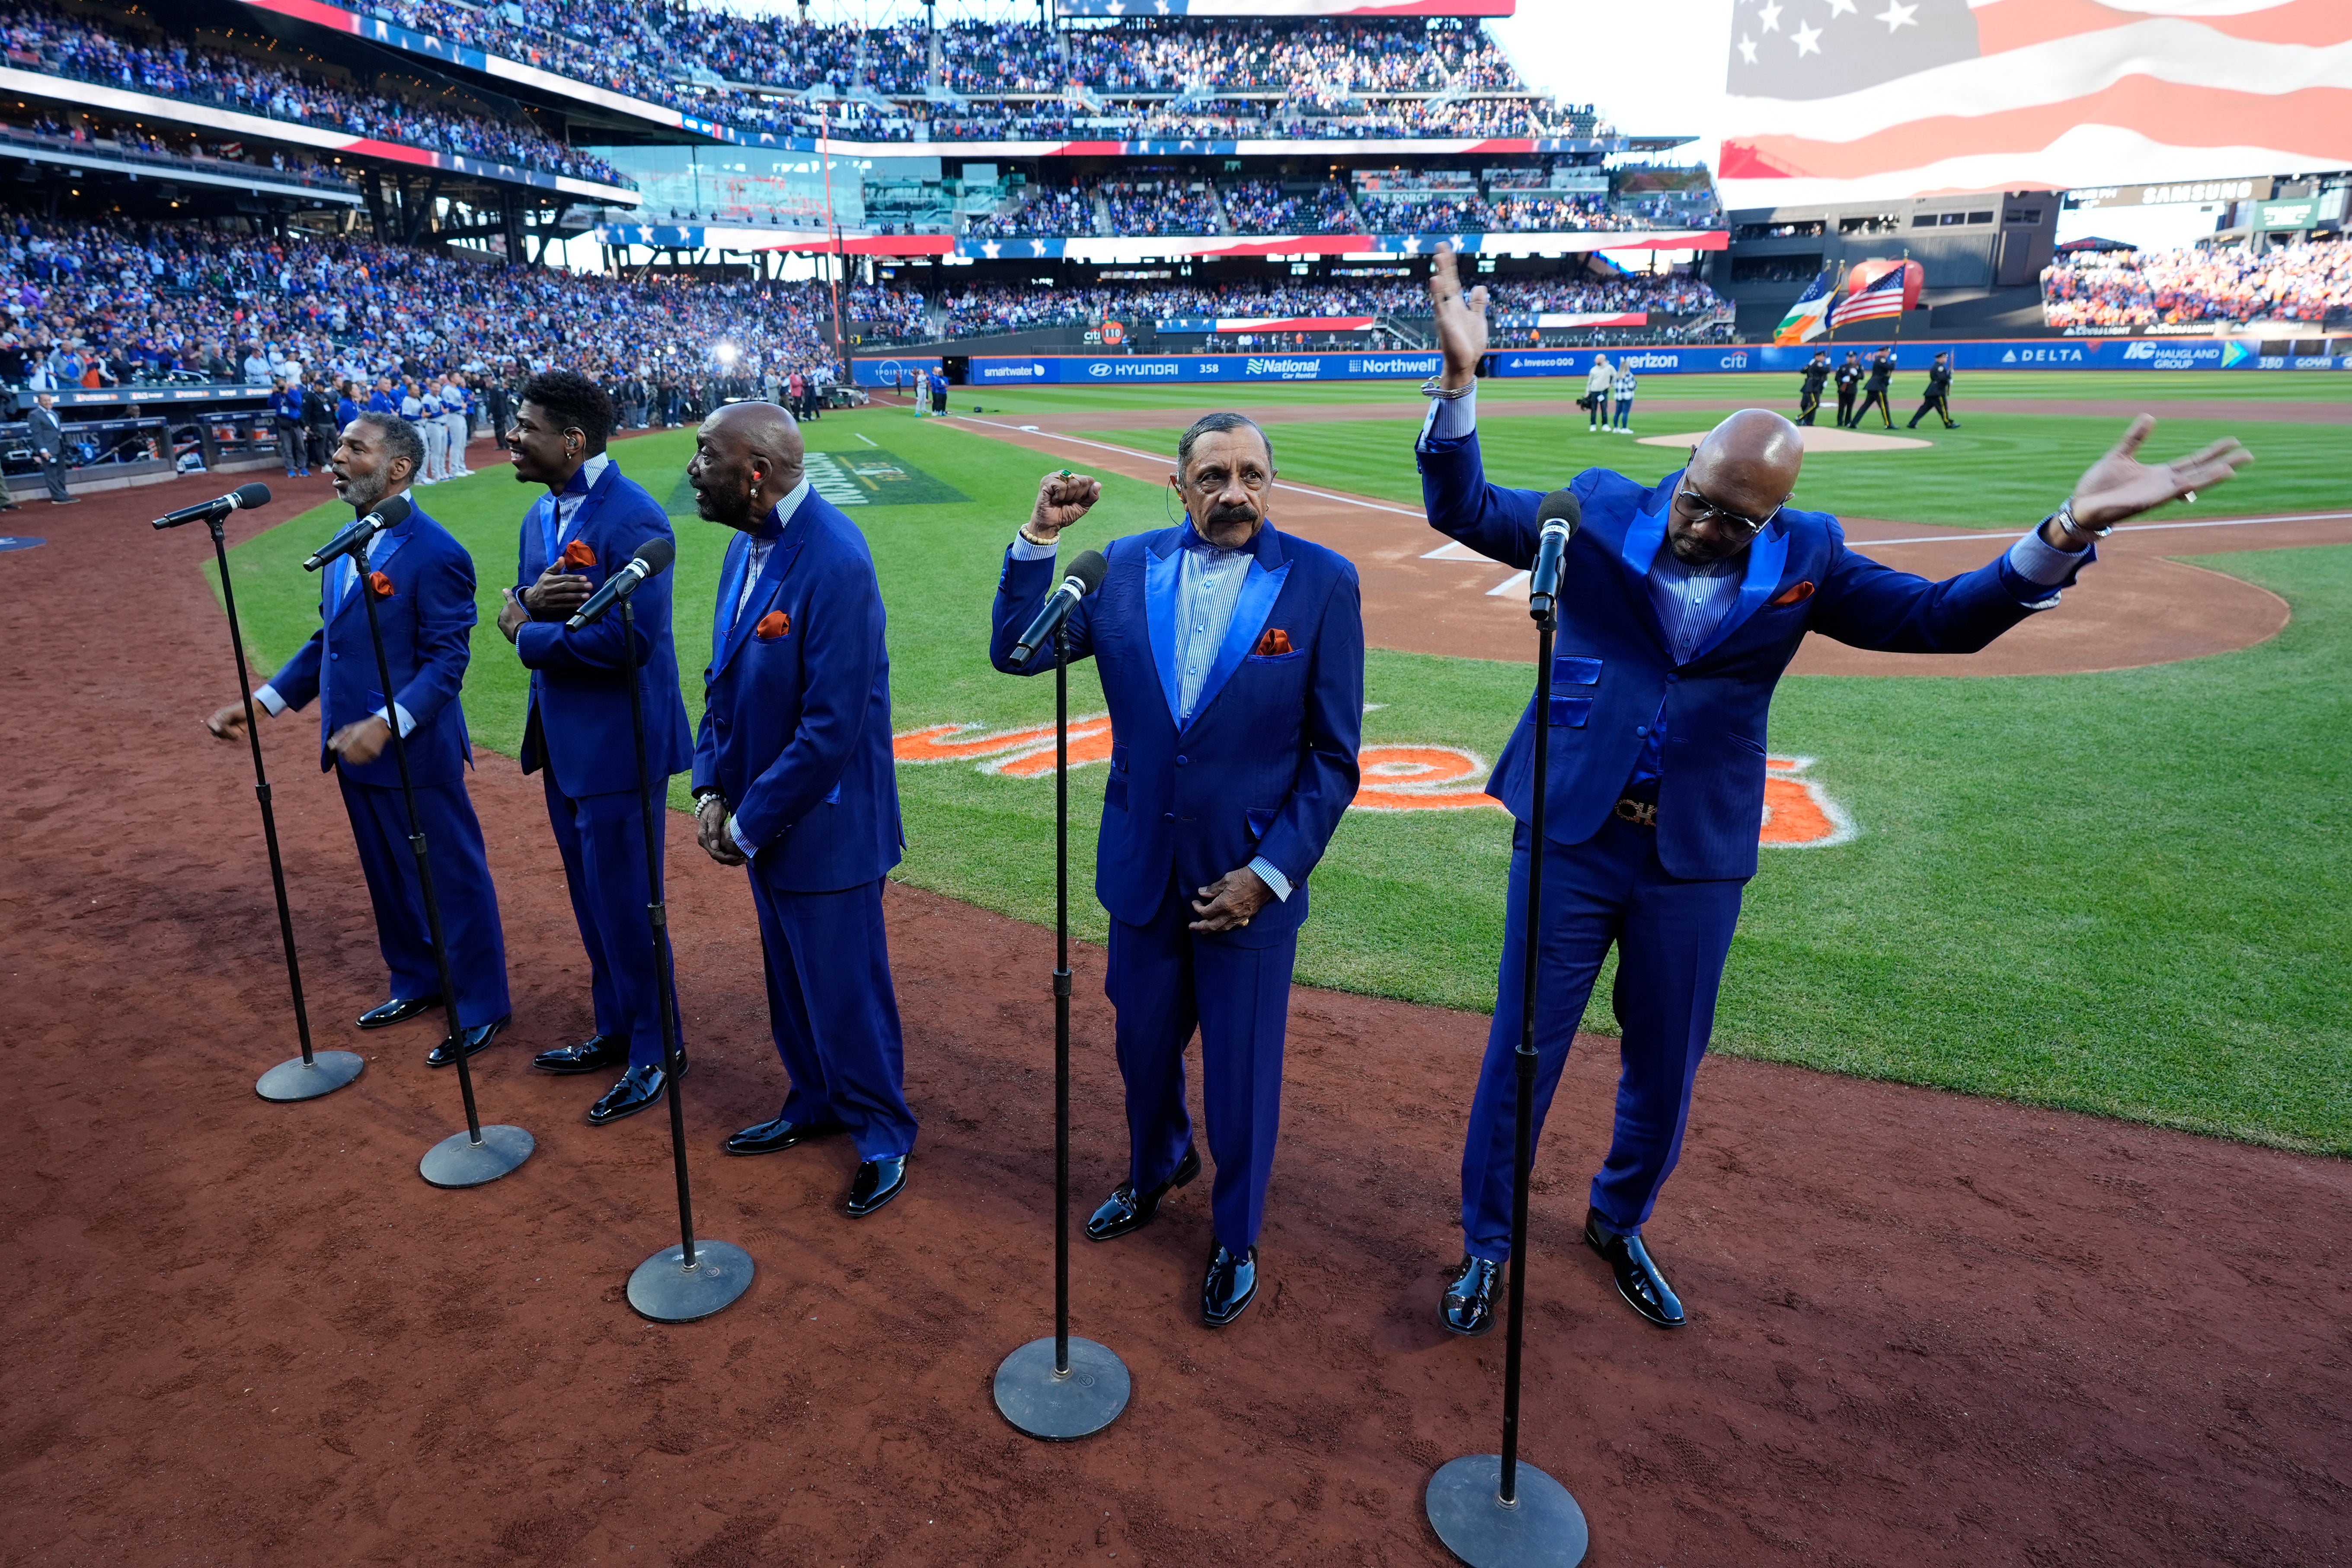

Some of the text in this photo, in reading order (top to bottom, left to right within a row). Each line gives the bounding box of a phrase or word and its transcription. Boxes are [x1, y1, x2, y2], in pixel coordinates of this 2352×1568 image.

[2142, 181, 2253, 204] SAMSUNG
[1084, 329, 1101, 340] citi
[1105, 329, 1121, 337] 110
[2021, 349, 2083, 361] DELTA
[2155, 349, 2220, 359] HAUGLAND
[1263, 358, 1320, 373] National
[1363, 358, 1436, 373] Northwell
[1524, 358, 1556, 367] Invesco
[1720, 352, 1748, 368] citi
[2154, 359, 2194, 369] GROUP
[984, 367, 1033, 377] smartwater
[1115, 364, 1179, 375] HYUNDAI
[1199, 364, 1219, 373] 358
